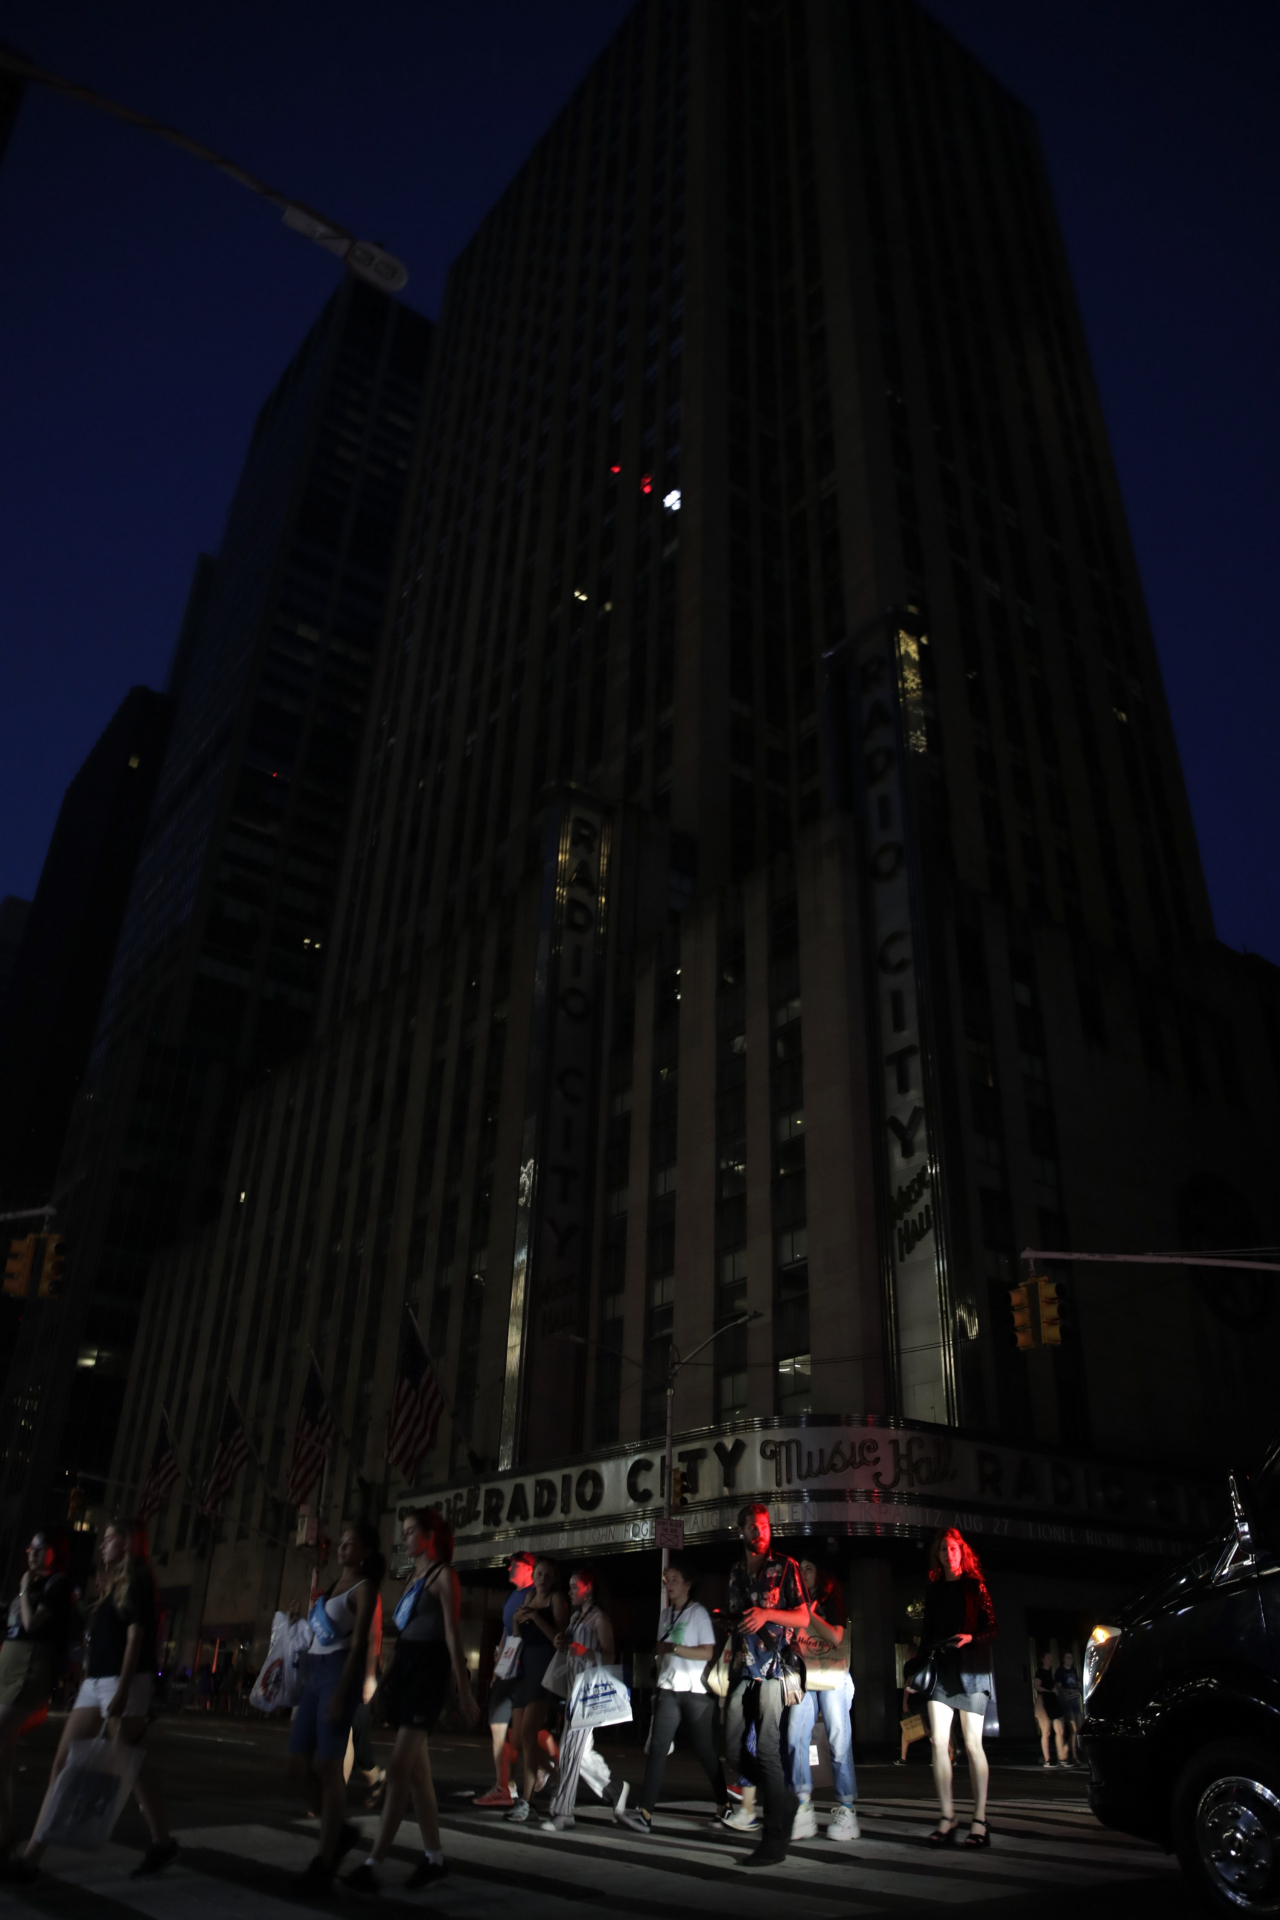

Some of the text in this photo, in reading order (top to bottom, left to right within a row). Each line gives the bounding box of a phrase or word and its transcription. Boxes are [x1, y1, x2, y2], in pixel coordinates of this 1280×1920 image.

[546, 815, 598, 1258] RADIO CITY
[860, 655, 925, 1158] RADIO CITY
[483, 1468, 605, 1527] RADIO
[627, 1438, 746, 1503] CITY
[760, 1438, 881, 1488] Music
[873, 1436, 958, 1490] Hall
[976, 1448, 1128, 1515] RADIO
[691, 1511, 720, 1532] AUG
[776, 1502, 847, 1523] LENNY
[861, 1502, 942, 1528] KRATZ
[953, 1512, 983, 1533] AUG
[993, 1517, 1011, 1536] 27
[1029, 1522, 1078, 1545] LIONEL
[1084, 1529, 1127, 1551] RICHIE
[1131, 1535, 1165, 1555] JULY
